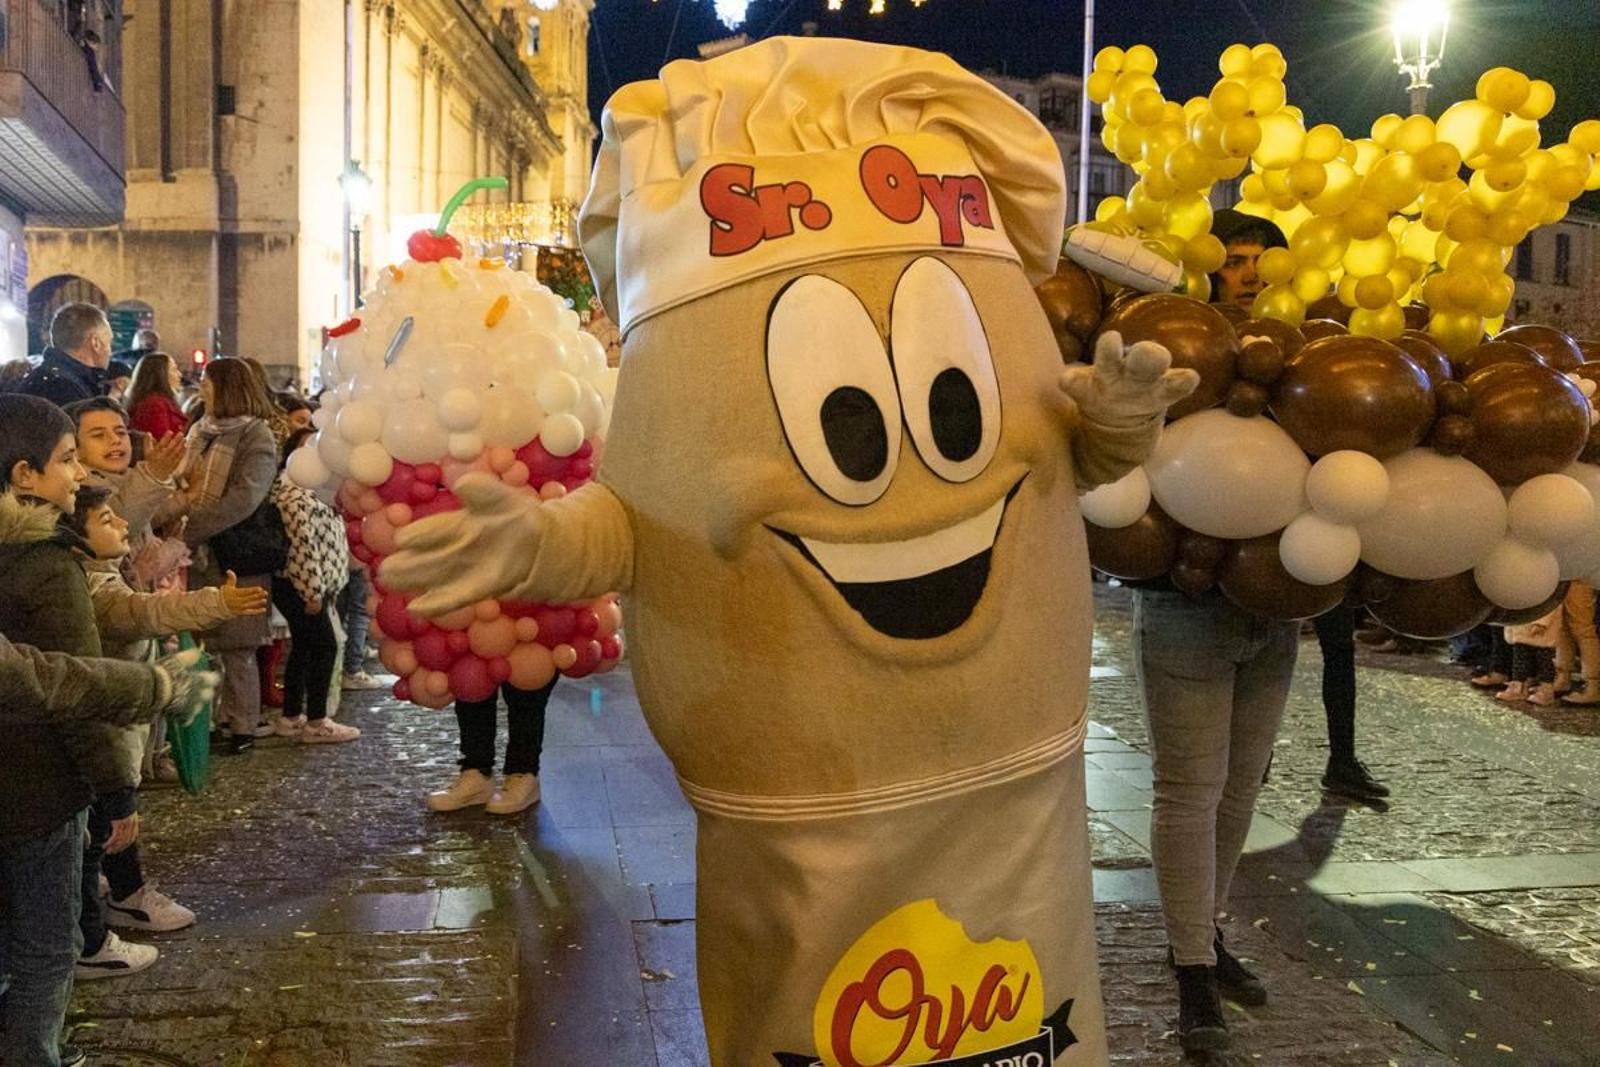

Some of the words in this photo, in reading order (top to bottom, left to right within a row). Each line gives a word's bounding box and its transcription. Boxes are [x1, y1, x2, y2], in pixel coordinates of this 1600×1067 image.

[700, 163, 832, 256] Sr.
[859, 144, 994, 246] Oya
[831, 948, 1030, 1067] Oya
